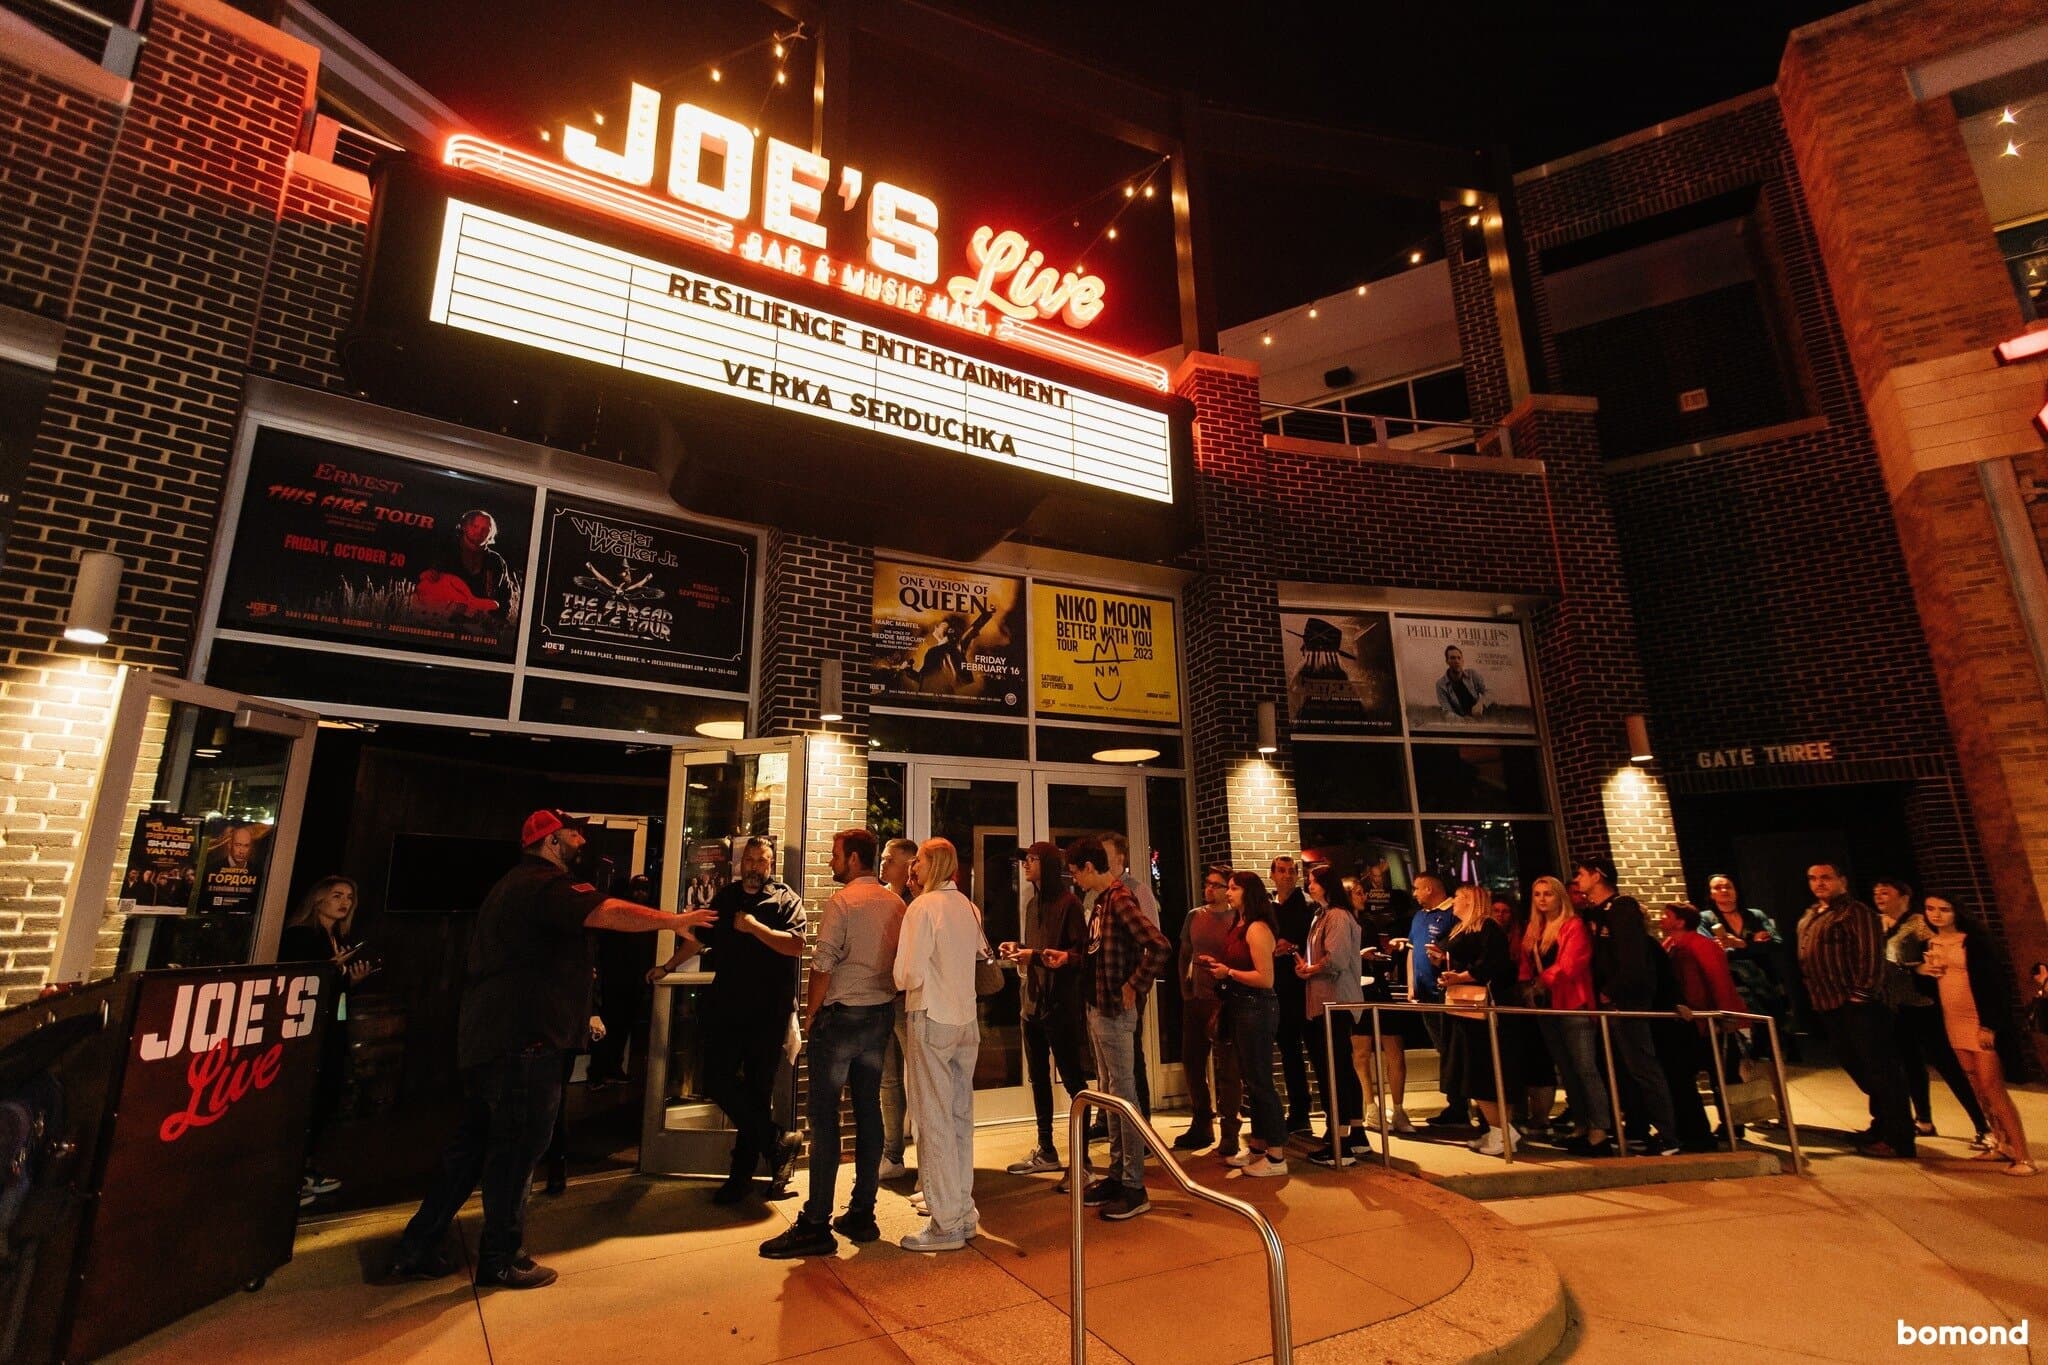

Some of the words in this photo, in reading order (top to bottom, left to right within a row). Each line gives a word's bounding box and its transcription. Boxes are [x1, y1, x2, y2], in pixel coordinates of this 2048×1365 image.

[563, 81, 939, 284] JOE'S
[740, 231, 806, 276] BAR
[812, 253, 836, 285] &
[842, 262, 926, 313] MUSIC
[948, 225, 1107, 330] Live
[667, 273, 846, 346] RESILIENCE
[861, 329, 1069, 410] ENTERTAINMENT
[722, 359, 833, 410] VERKA
[850, 396, 1018, 459] SERDUCHKA
[315, 463, 403, 494] ERNEST
[267, 484, 317, 506] THIS
[375, 505, 434, 530] TOUR
[571, 517, 654, 548] Wheeler
[284, 534, 328, 556] FRIDAY,
[334, 545, 385, 564] OCTOBER
[590, 535, 657, 562] Walker
[658, 550, 679, 568] Jr.
[899, 575, 928, 590] ONE
[932, 578, 970, 593] VISION
[973, 584, 989, 595] OF
[561, 592, 598, 611] THE
[604, 600, 674, 624] SPREAD
[899, 586, 990, 616] QUEEN
[1055, 593, 1097, 623] NIKO
[1103, 600, 1152, 630] MOON
[626, 617, 672, 642] TOUR
[1056, 620, 1097, 641] BETTER
[1100, 625, 1128, 645] WITH
[1131, 629, 1153, 647] YOU
[1407, 624, 1452, 639] PHILLIP
[1457, 627, 1509, 641] PHILLIPS
[974, 654, 1007, 666] FRIDAY
[1057, 638, 1078, 653] TOUR
[1133, 647, 1153, 660] 2023
[961, 661, 1008, 675] FEBRUARY
[1010, 665, 1020, 676] 16
[1095, 665, 1104, 677] N
[1108, 665, 1119, 677] M
[1698, 748, 1754, 768] GATE
[1763, 742, 1833, 763] THREE
[208, 873, 257, 886] ГОРДОН
[140, 975, 321, 1062] JOE'S
[160, 1037, 283, 1142] Live
